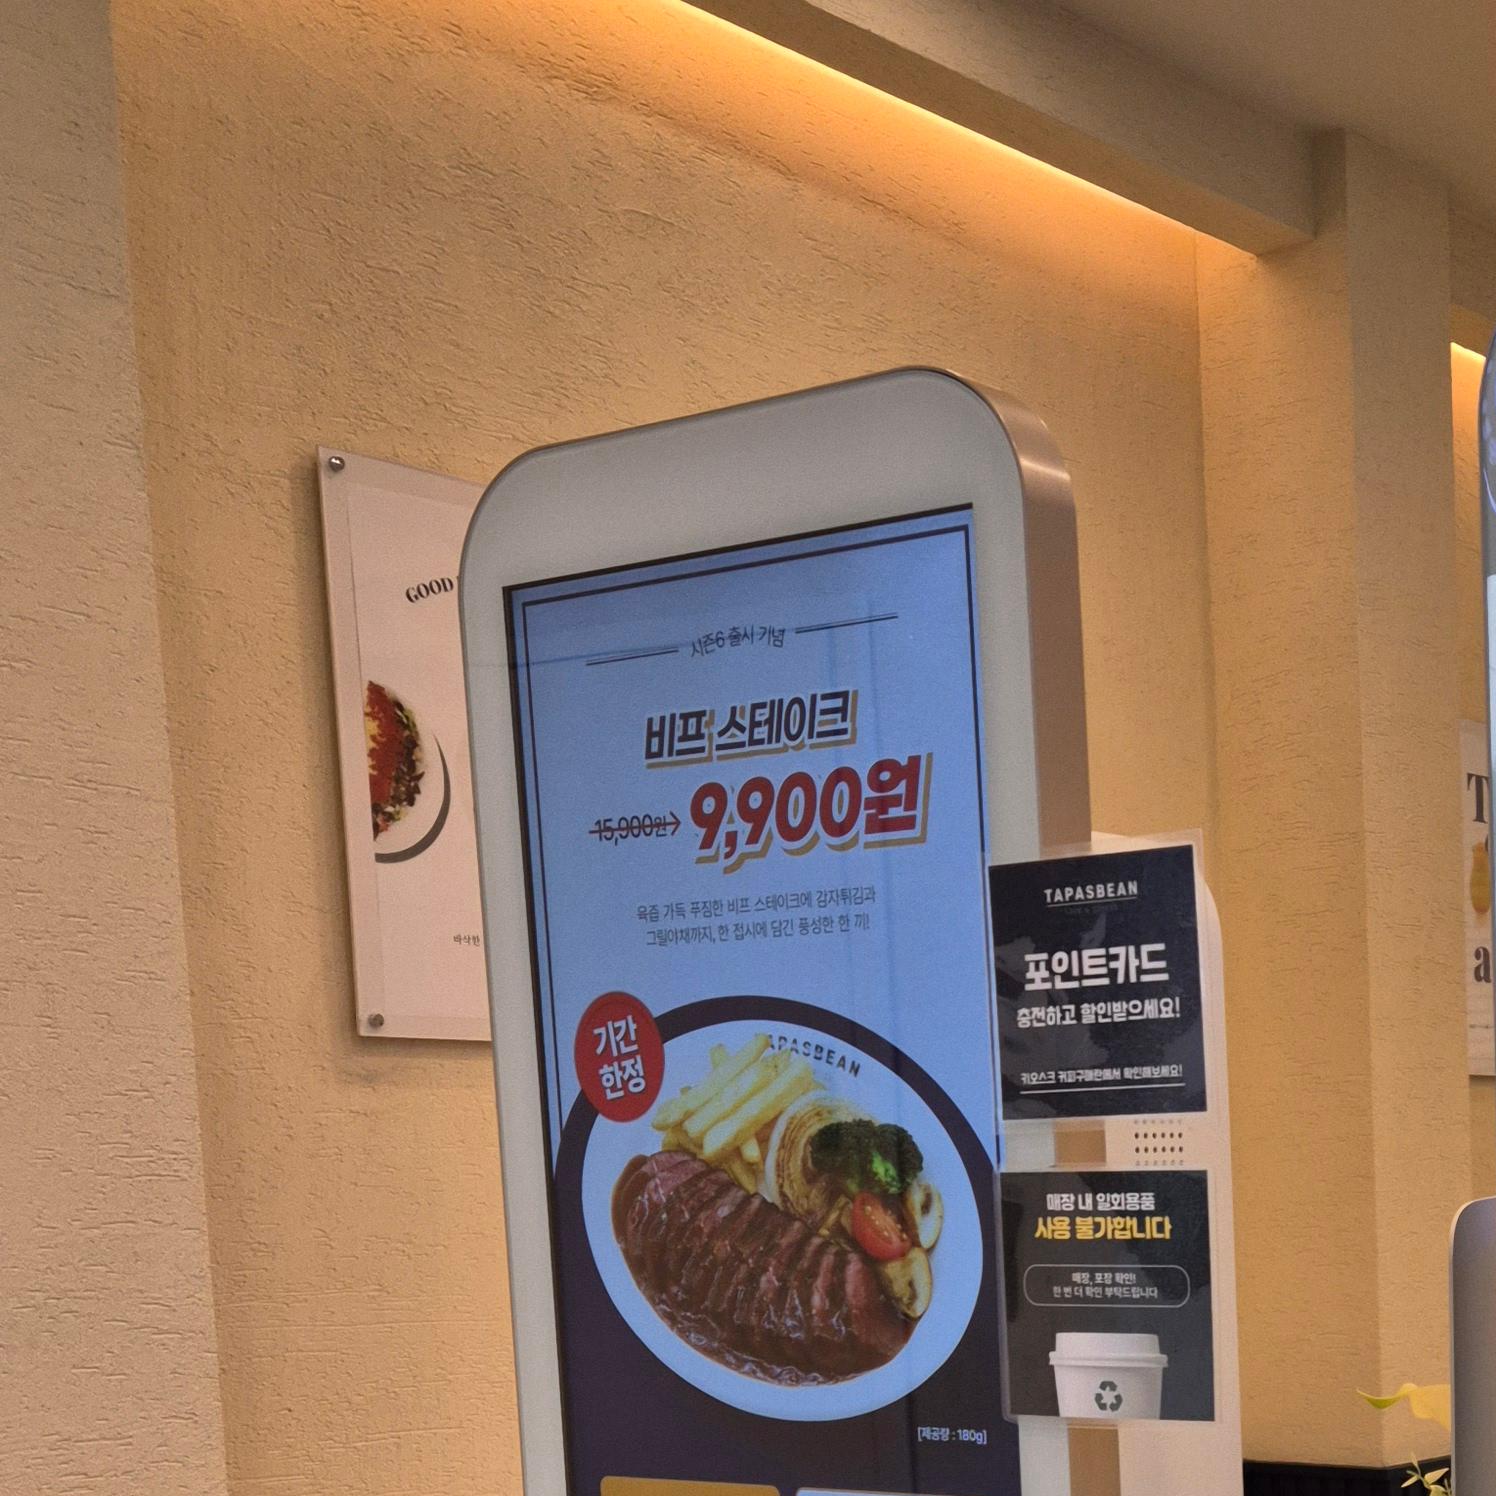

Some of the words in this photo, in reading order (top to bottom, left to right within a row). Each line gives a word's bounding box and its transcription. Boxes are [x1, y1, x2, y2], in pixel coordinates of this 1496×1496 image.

[406, 577, 454, 603] GOOD
[691, 631, 726, 657] 시즌6
[728, 624, 754, 647] 출시
[759, 625, 785, 647] 기념
[645, 708, 710, 763] 비프
[715, 690, 854, 753] 스테이크
[689, 754, 924, 863] 9,900원
[664, 902, 686, 919] 가득
[727, 896, 751, 913] 비프
[754, 890, 812, 912] 스테이크에
[816, 886, 876, 907] 감자튀김과
[1044, 880, 1138, 903] TAPASBEAN
[718, 924, 729, 942] 한
[733, 920, 767, 939] 접시에
[771, 919, 794, 937] 담긴
[799, 916, 834, 936] 풍성한
[839, 914, 851, 931] 한
[1024, 942, 1169, 991] 포인트카드
[1016, 1004, 1077, 1028] 충전하고
[1080, 996, 1181, 1024] 할인받으세요!
[593, 1015, 639, 1057] 기간
[768, 1034, 861, 1077] PASBEAN
[599, 1056, 646, 1100] 한정
[1021, 1071, 1056, 1085] 키오스크
[1046, 1193, 1074, 1212] 매장
[1078, 1193, 1093, 1211] 내
[1096, 1192, 1155, 1211] 일회용품
[1035, 1216, 1071, 1240] 사용
[1075, 1215, 1172, 1240] 불가합니다
[1085, 1286, 1102, 1298] 확인
[1105, 1285, 1158, 1299] 부탁드립니다
[1094, 1272, 1113, 1284] 포장
